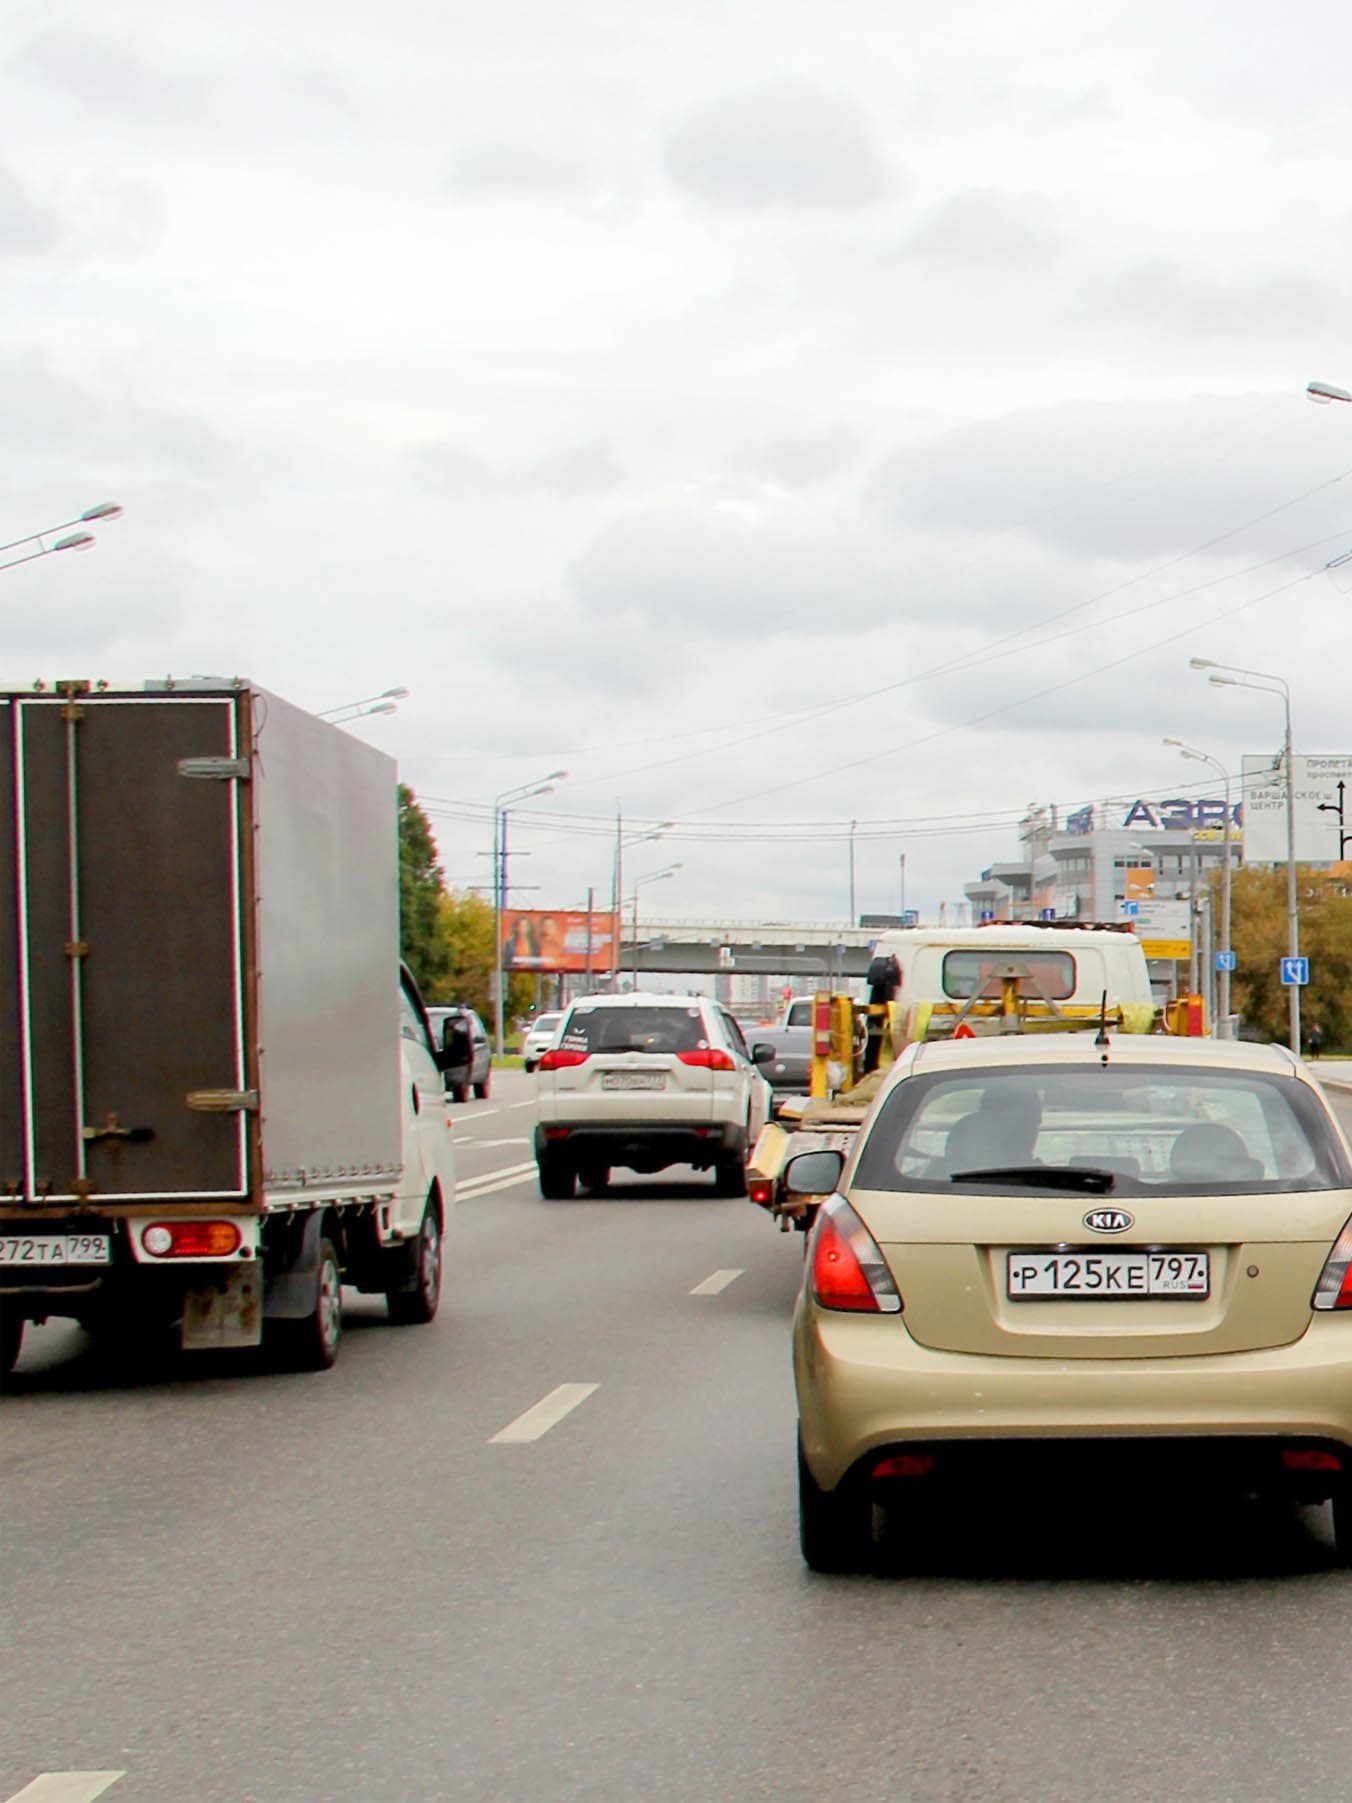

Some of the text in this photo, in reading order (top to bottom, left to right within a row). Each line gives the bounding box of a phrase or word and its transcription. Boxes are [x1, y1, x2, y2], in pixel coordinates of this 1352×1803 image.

[1250, 791, 1321, 800] ВАРШАСКОЕ
[1250, 802, 1285, 811] ЦЕНТР
[1090, 1214, 1126, 1228] KIA
[69, 1237, 103, 1254] 799
[1151, 1257, 1199, 1280] 797
[1163, 1281, 1186, 1289] RUS
